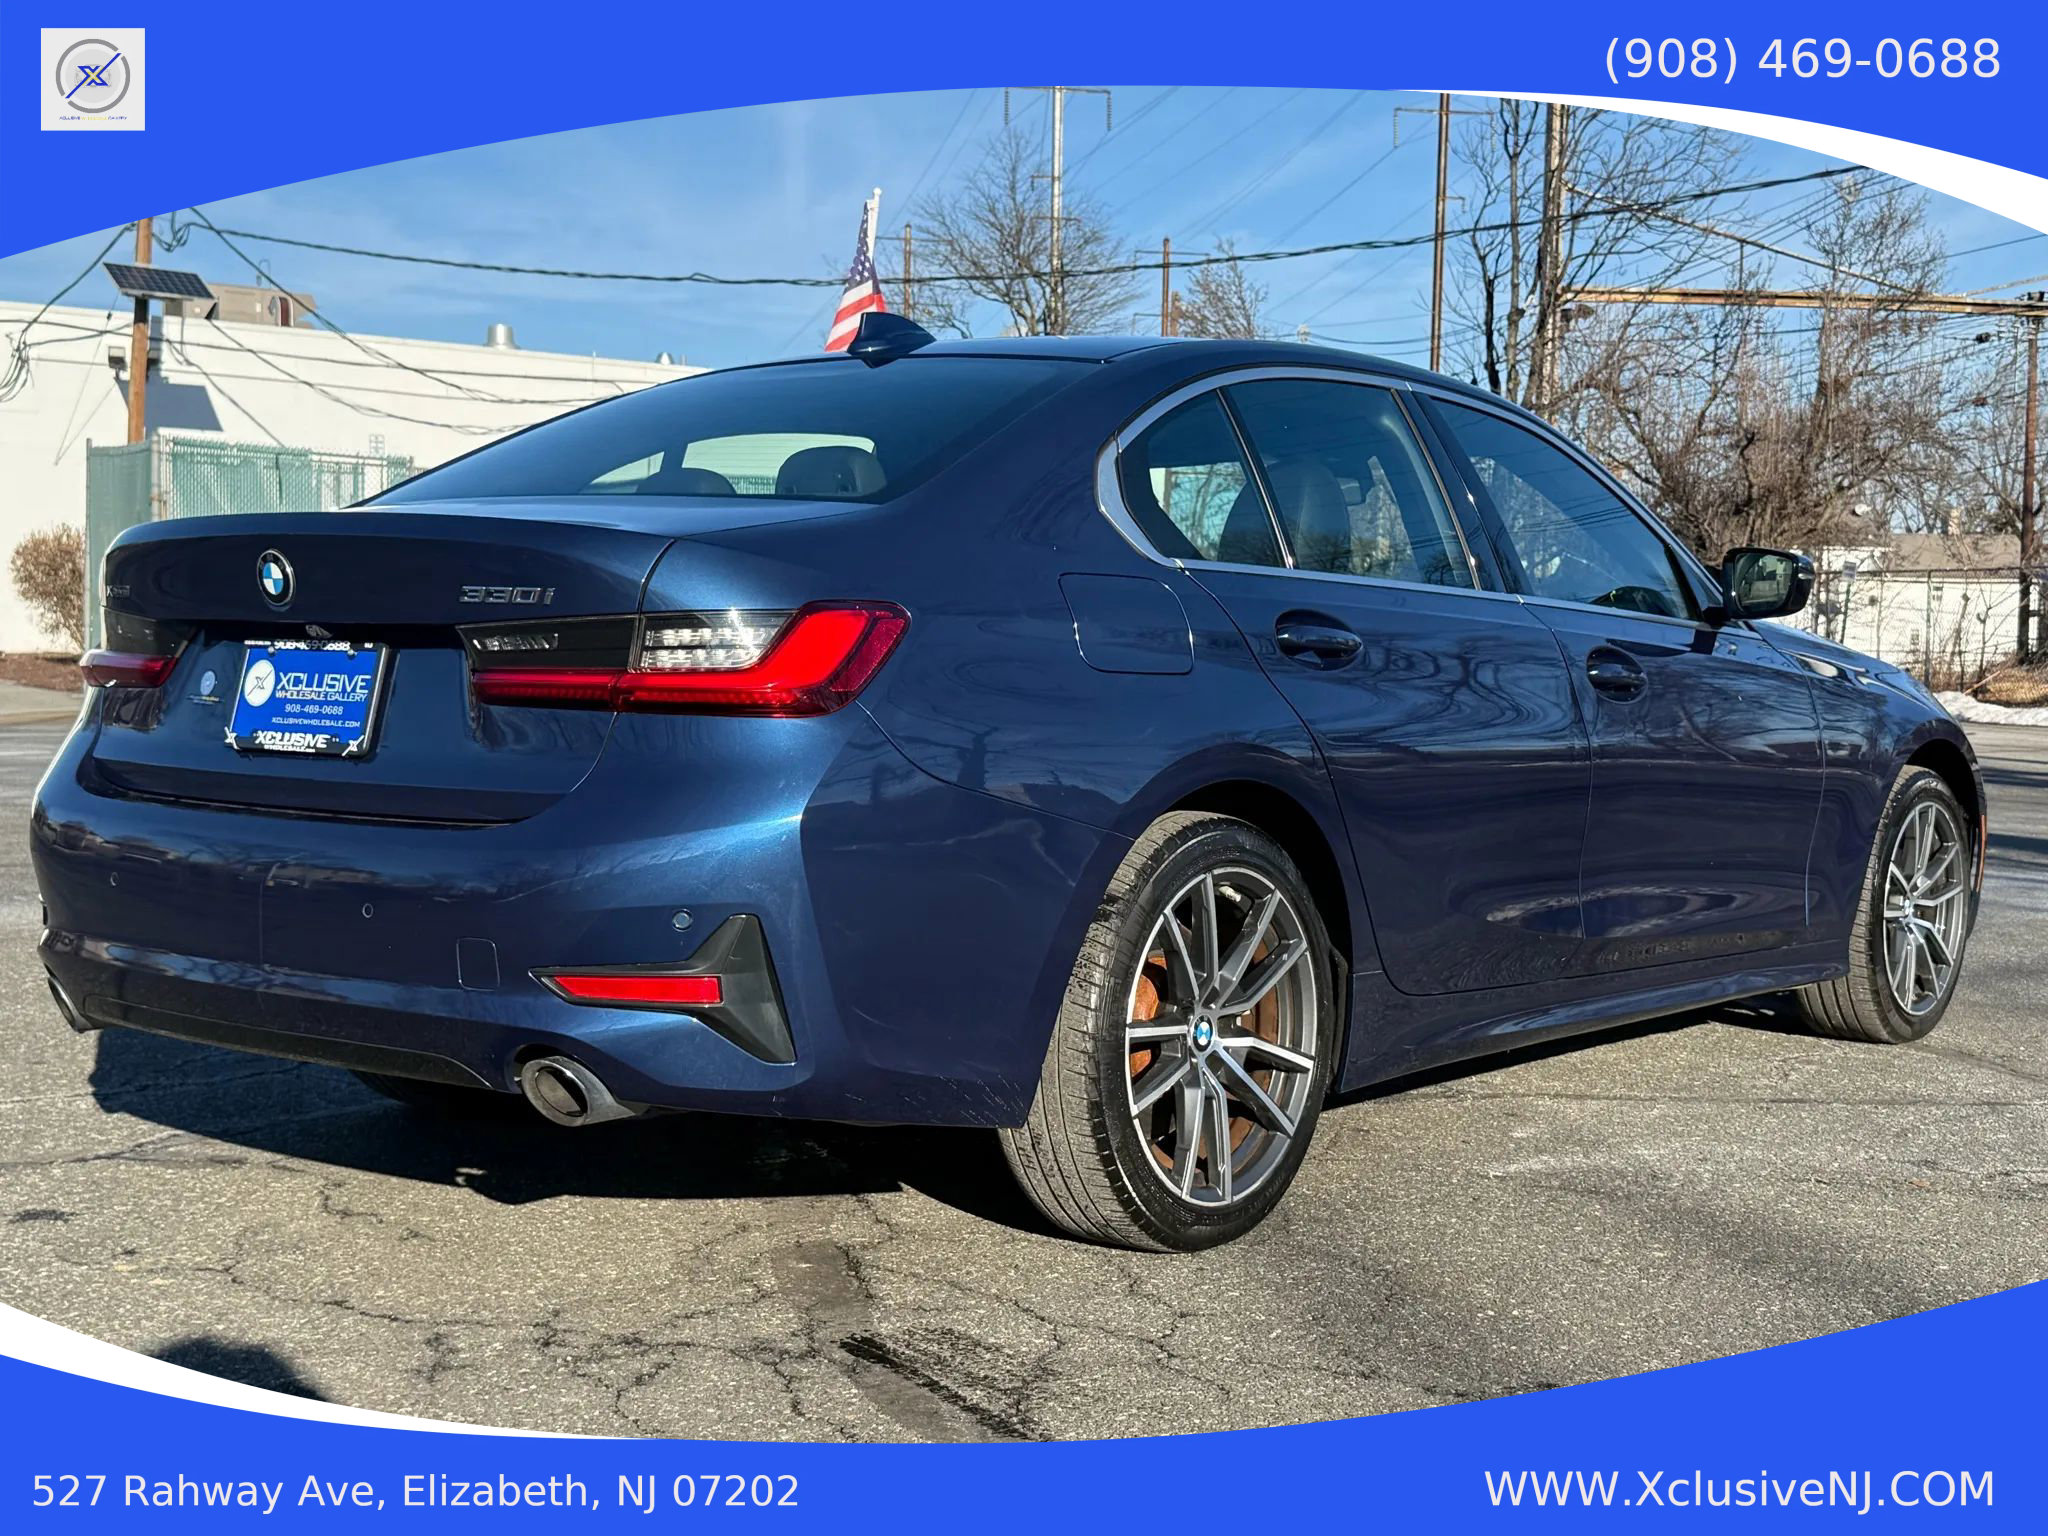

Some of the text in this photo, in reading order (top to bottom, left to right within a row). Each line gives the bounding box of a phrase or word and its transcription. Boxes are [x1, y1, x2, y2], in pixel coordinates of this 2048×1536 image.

[458, 585, 556, 605] 330i
[277, 672, 371, 694] XCLUSIVE
[275, 689, 368, 703] WHOLESALE GALLERY
[284, 703, 345, 716] 908-469-0688
[271, 716, 361, 728] XCLUSIVEWHOLESALE.COM
[254, 731, 331, 749] XCLUSIVE
